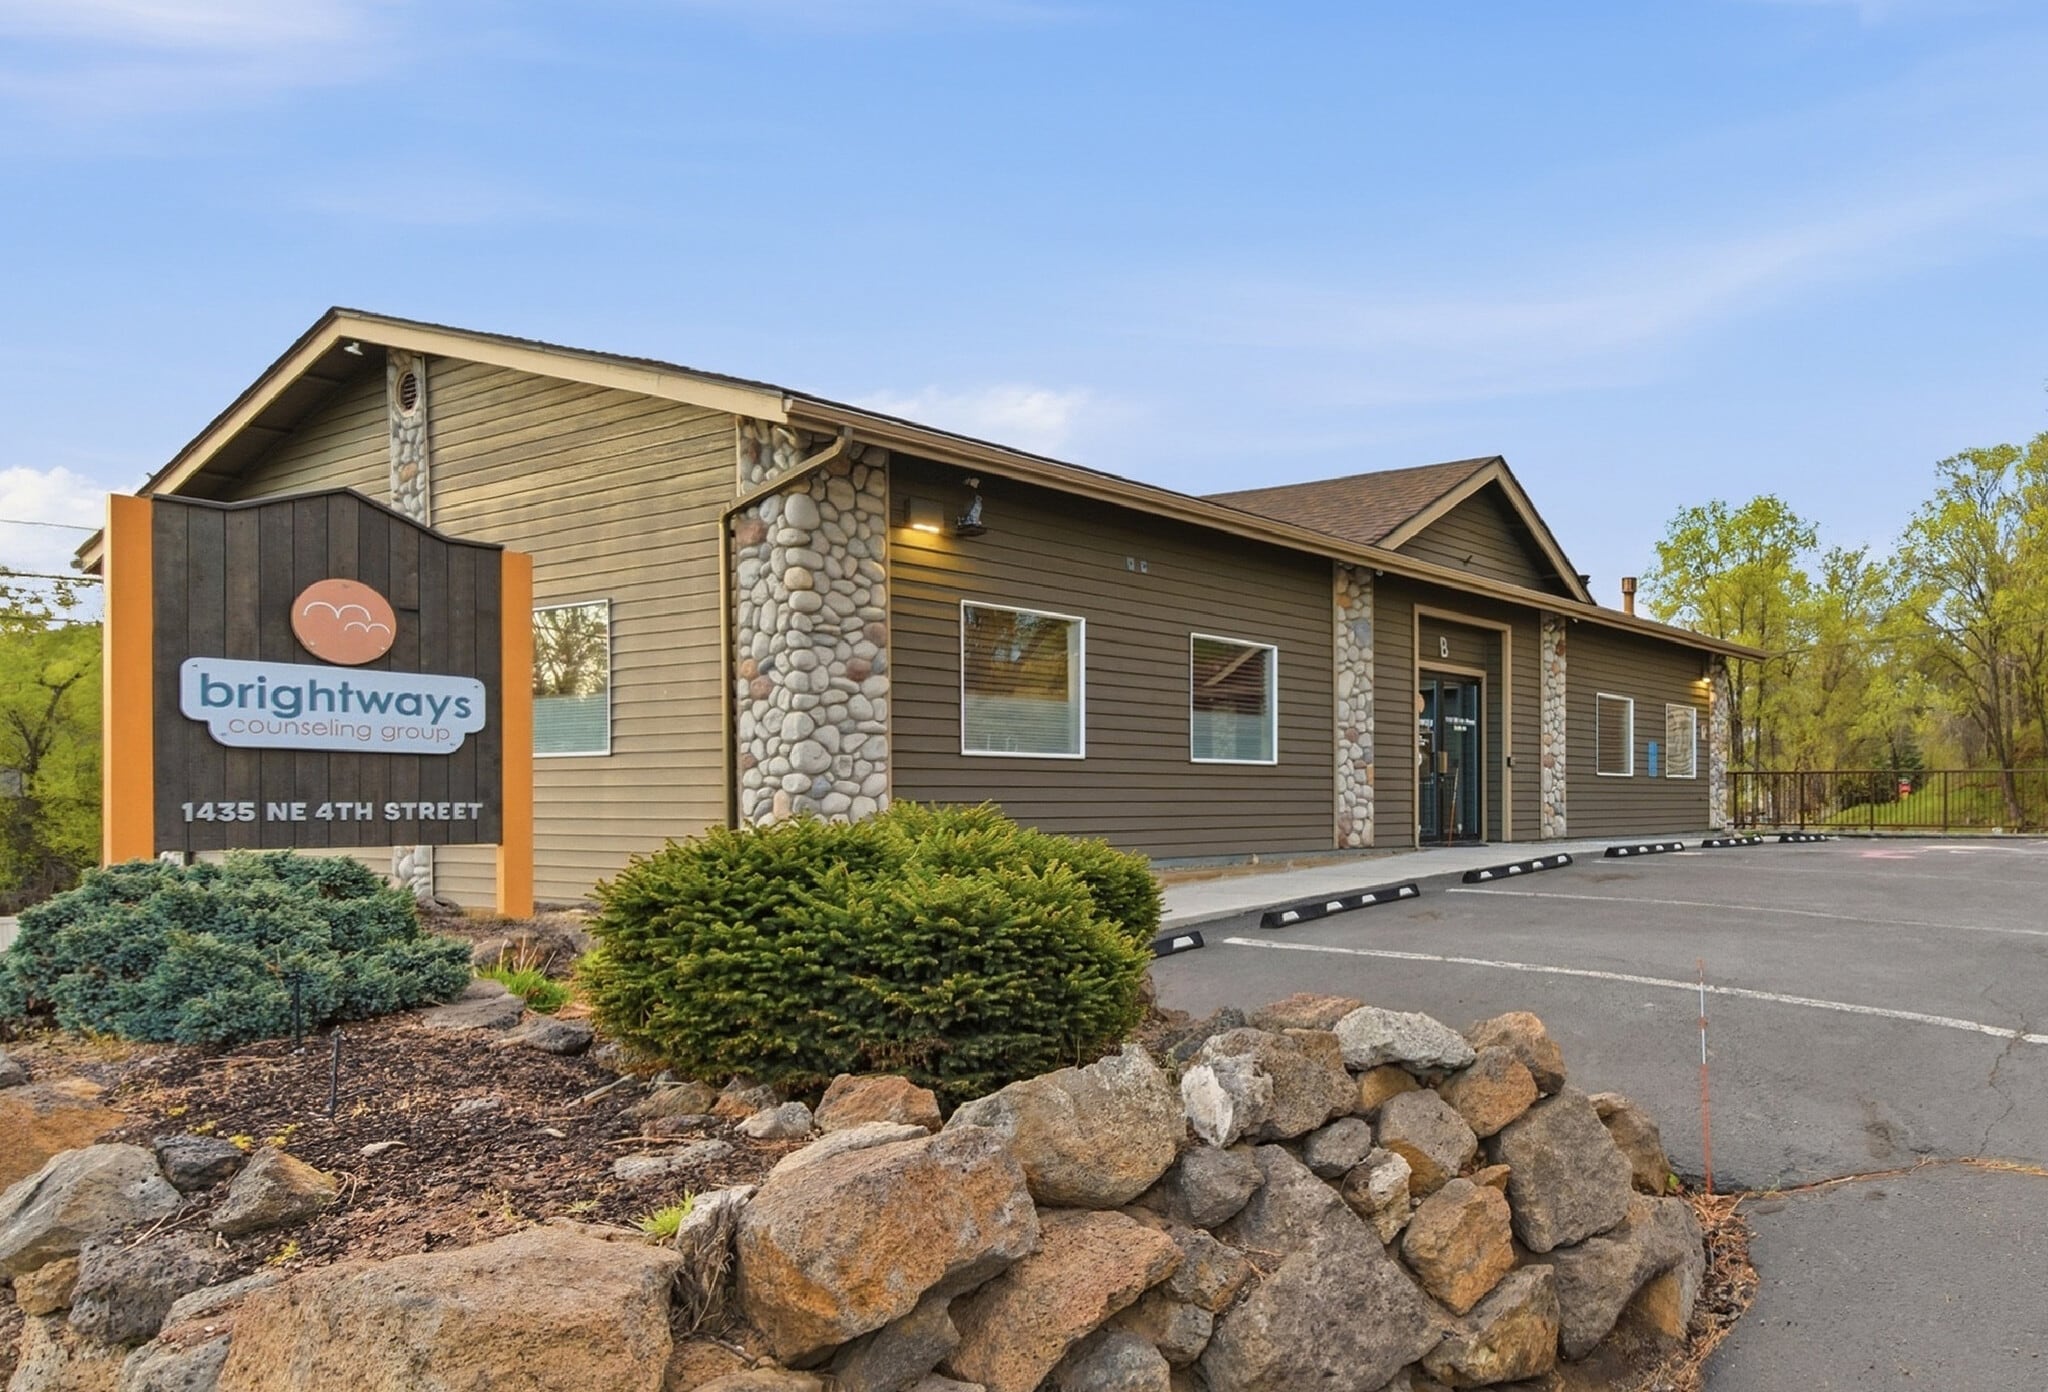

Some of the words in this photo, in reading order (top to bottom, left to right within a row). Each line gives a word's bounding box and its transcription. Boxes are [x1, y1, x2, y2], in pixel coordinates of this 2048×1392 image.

[1439, 636, 1449, 658] B
[200, 673, 472, 725] brightways
[228, 718, 372, 741] counseling
[380, 727, 451, 743] group
[181, 802, 256, 822] 1435
[265, 802, 307, 821] NE
[314, 802, 373, 821] 4TH
[384, 802, 484, 821] STREET
